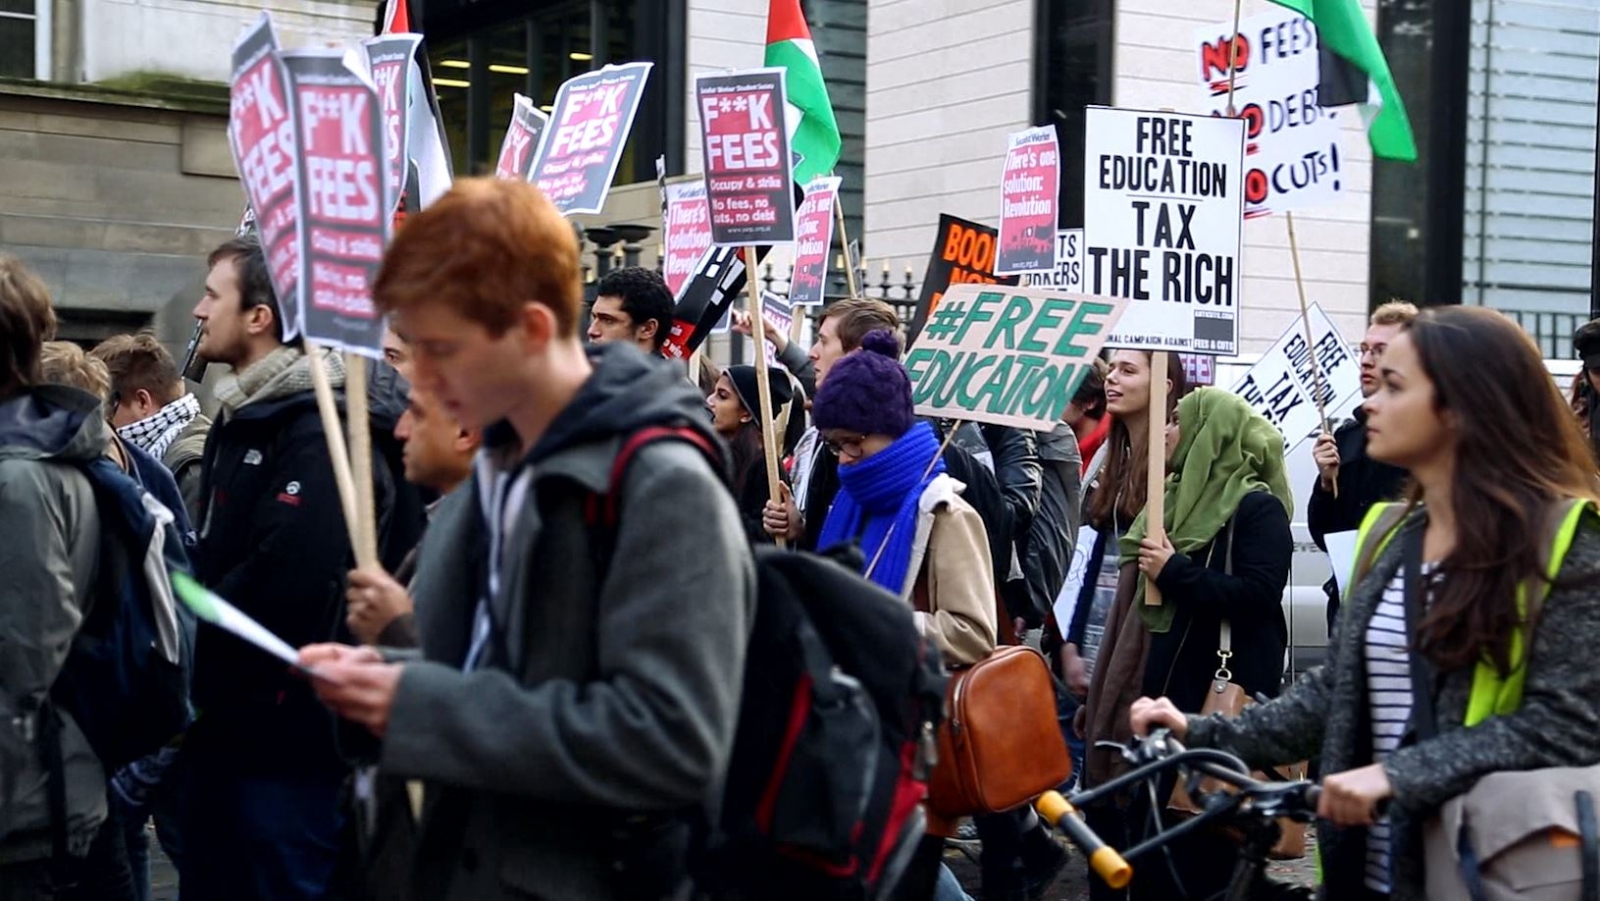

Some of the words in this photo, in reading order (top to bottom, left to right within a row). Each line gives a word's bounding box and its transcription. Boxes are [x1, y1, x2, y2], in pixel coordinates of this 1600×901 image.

[1201, 32, 1249, 82] NO
[1260, 16, 1313, 64] FEES
[549, 114, 619, 158] FEES
[706, 131, 780, 170] FEES
[1136, 116, 1193, 157] FREE
[1007, 147, 1037, 171] There's
[1039, 149, 1056, 167] one
[1099, 154, 1227, 198] EDUCATION
[1244, 167, 1268, 206] O
[1272, 142, 1341, 195] CUTS!
[306, 155, 380, 223] FEES
[710, 179, 743, 191] Occupy
[746, 178, 755, 188] &
[757, 176, 782, 188] strike
[726, 198, 753, 210] fees,
[755, 199, 769, 208] no
[1004, 171, 1045, 195] solution:
[735, 213, 750, 222] no
[752, 209, 776, 221] debt
[1004, 195, 1052, 219] Revolution
[1131, 200, 1196, 250] TAX
[1088, 246, 1150, 301] THE
[1162, 251, 1233, 307] RICH
[924, 291, 1115, 357] #FREE
[1123, 334, 1162, 345] CAMPAIGN
[1164, 337, 1193, 348] AGAINST
[1194, 339, 1210, 349] FEES
[1210, 339, 1216, 350] &
[1216, 340, 1234, 352] CUTS
[1313, 330, 1348, 376] FREE
[904, 348, 1093, 421] EDUCATION
[1265, 371, 1303, 423] TAX
